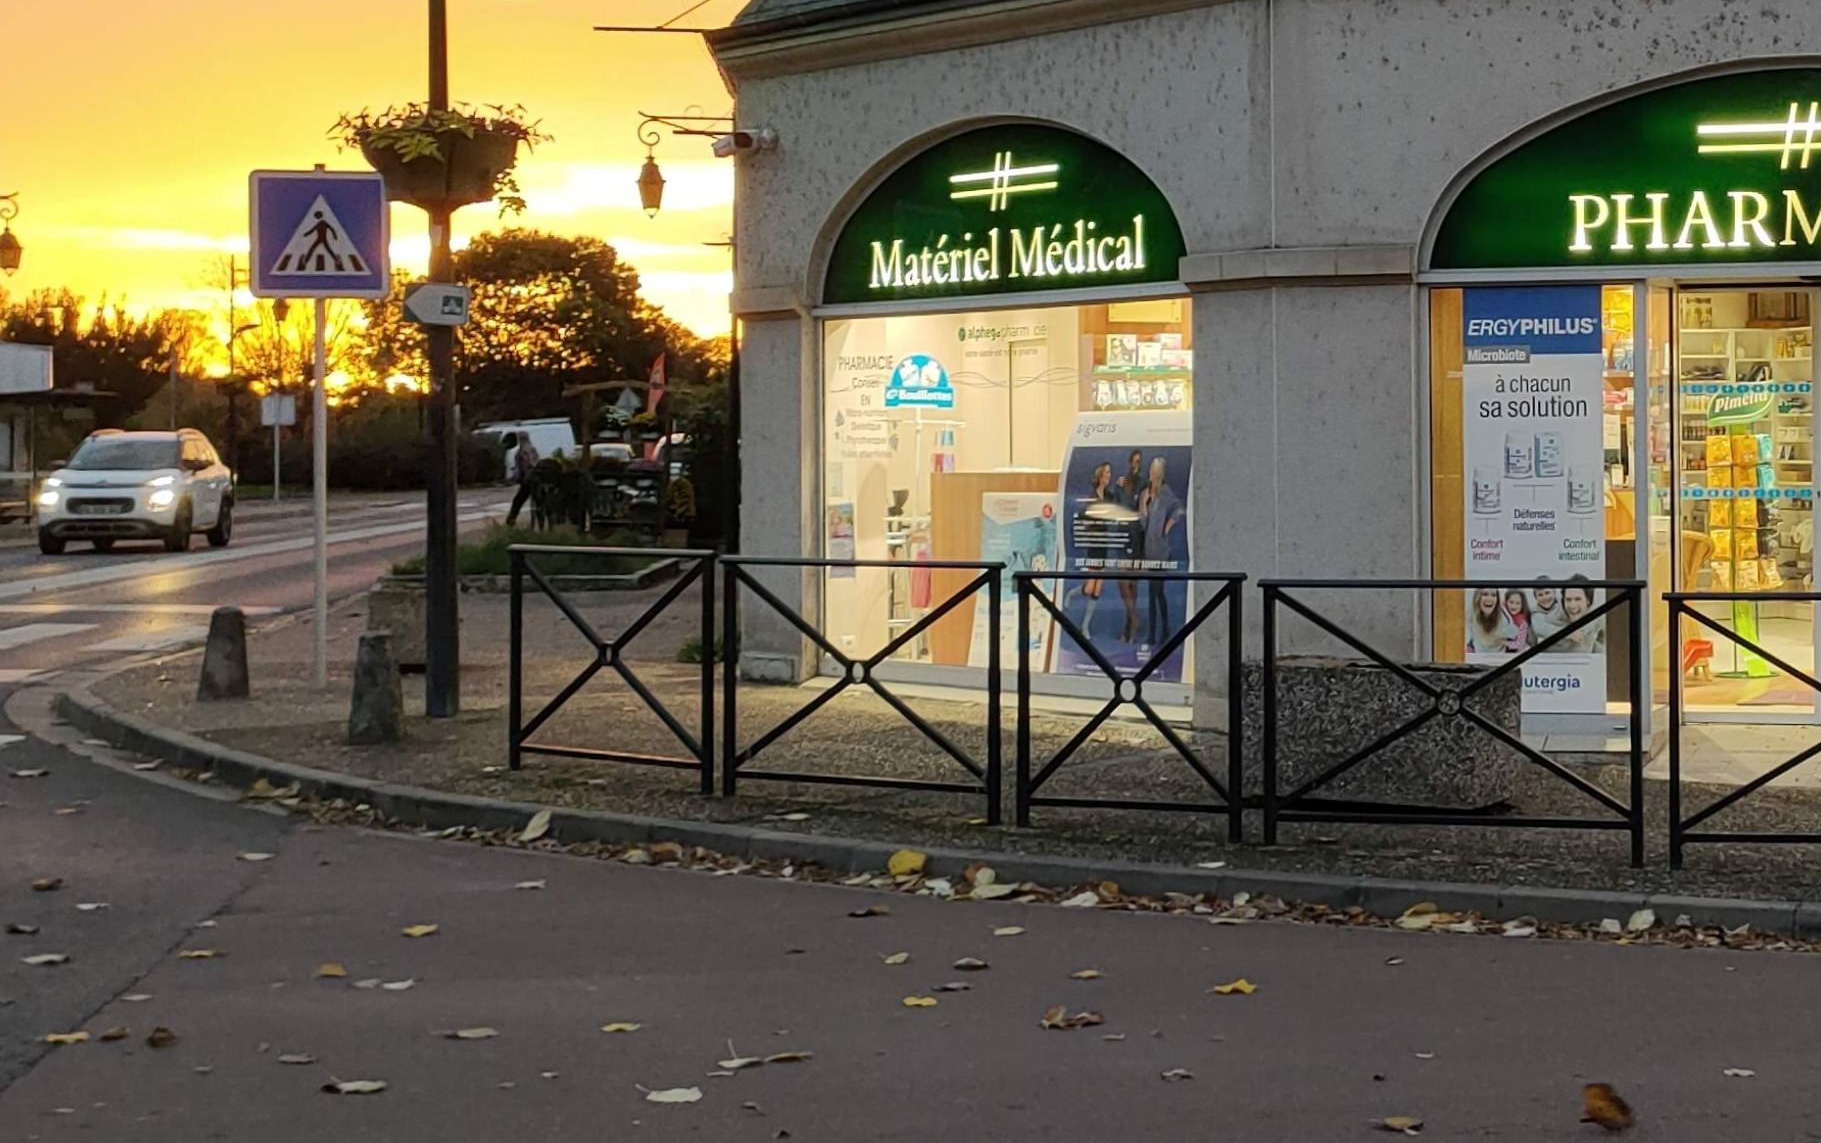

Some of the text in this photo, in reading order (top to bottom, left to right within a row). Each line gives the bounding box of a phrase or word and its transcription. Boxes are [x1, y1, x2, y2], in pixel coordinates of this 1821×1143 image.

[868, 213, 1146, 289] Matériel Médical
[1467, 349, 1527, 362] Microbiote
[838, 355, 894, 371] PHARMACIE
[1495, 374, 1571, 394] à chacun
[1479, 395, 1588, 419] sa solution
[1076, 422, 1117, 438] sigvaris
[1513, 509, 1556, 520] Défenses
[1513, 521, 1556, 531] naturelles
[1470, 539, 1504, 550] Confort
[1563, 539, 1597, 550] Confort
[1472, 551, 1501, 561] intime
[1558, 551, 1600, 561] intestinal
[1521, 673, 1581, 692] utergia
